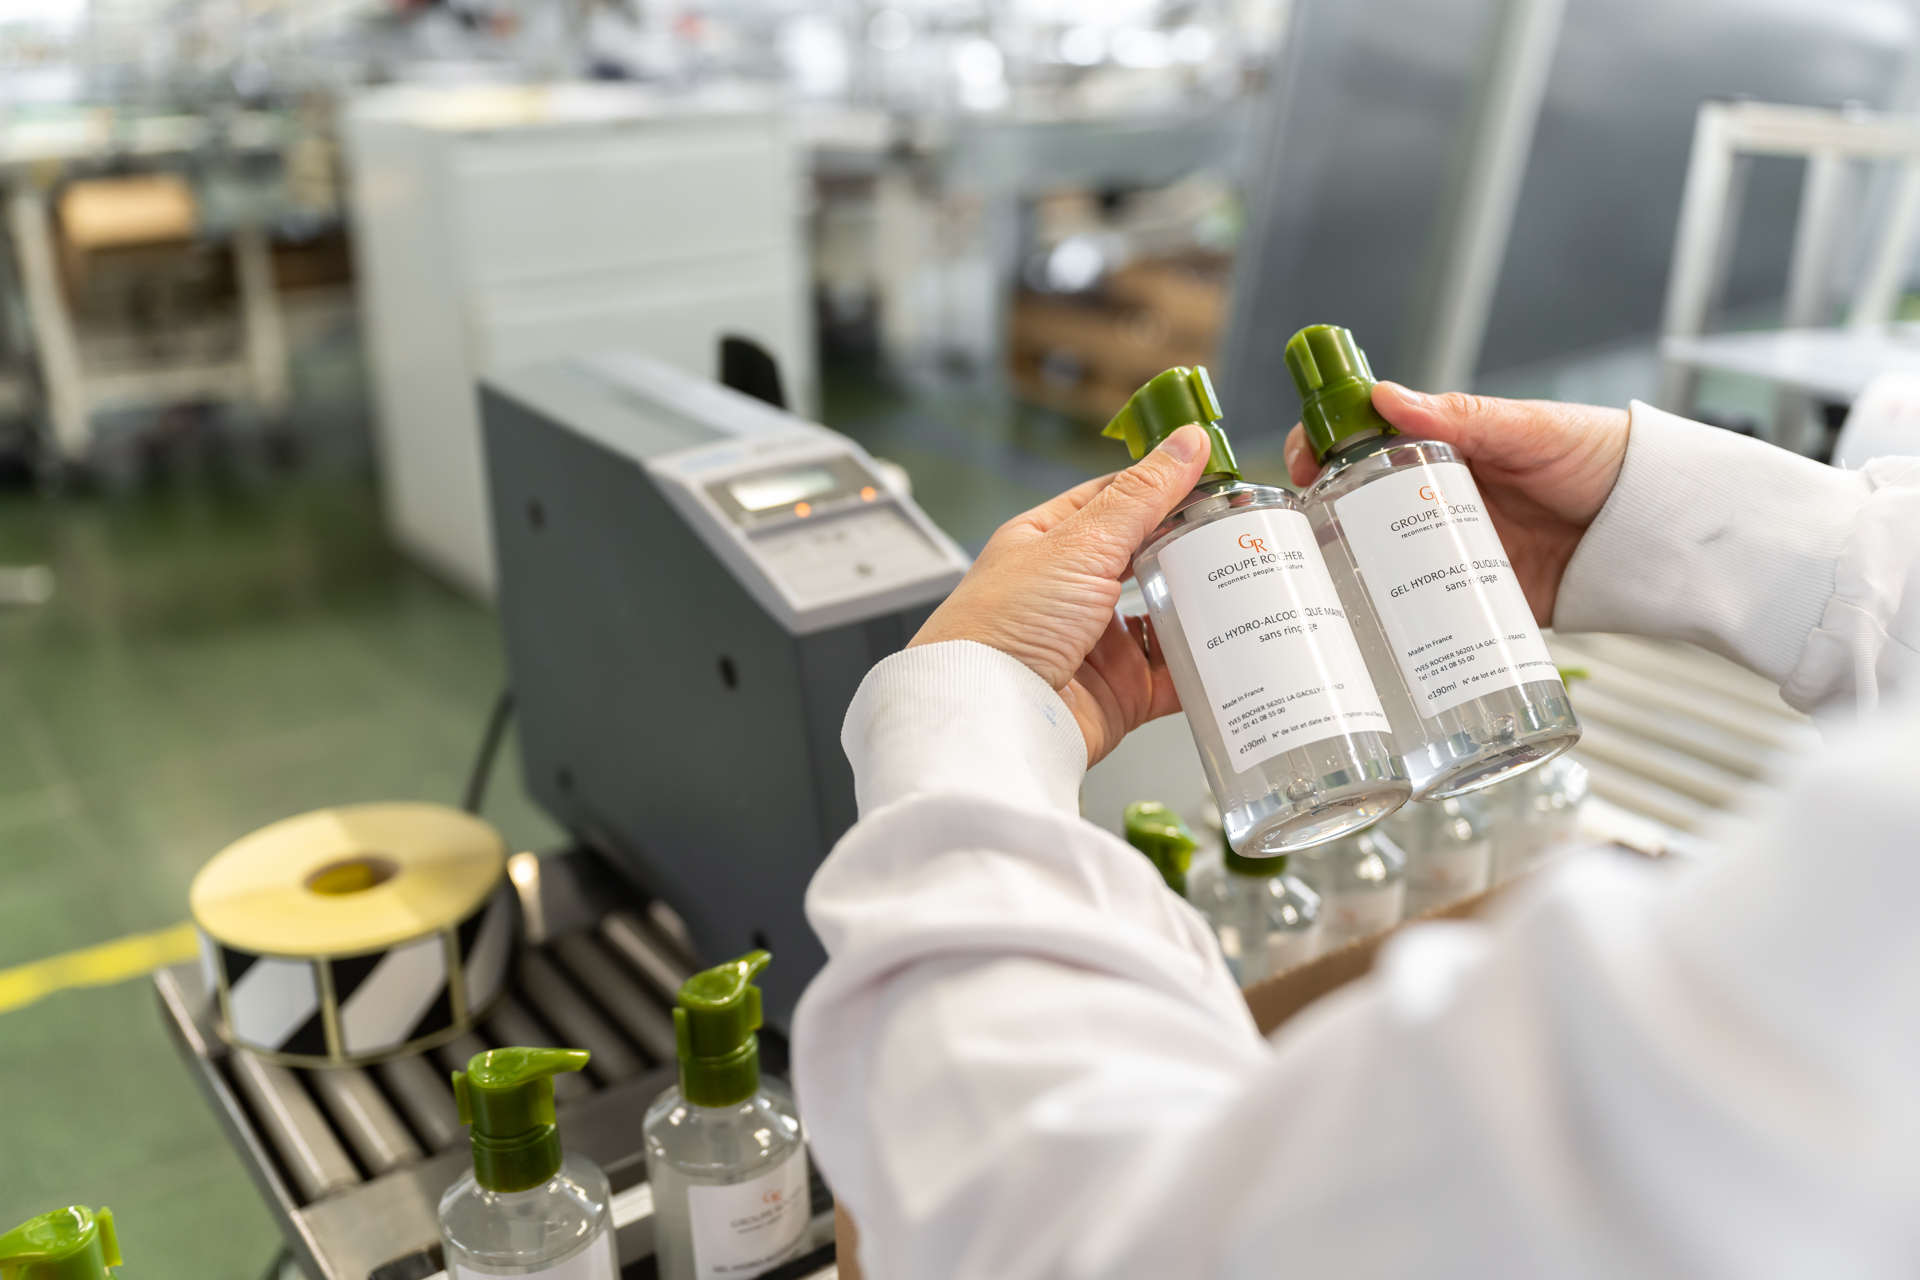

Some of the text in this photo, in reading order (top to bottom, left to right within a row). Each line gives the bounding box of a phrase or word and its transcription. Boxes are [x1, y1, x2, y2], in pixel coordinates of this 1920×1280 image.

[1390, 508, 1439, 532] GROUPE
[1401, 524, 1433, 539] reconnect
[1238, 534, 1267, 553] GR
[1208, 551, 1304, 582] GROUPE ROCHER
[1217, 573, 1250, 589] reconnect
[1253, 567, 1275, 578] people
[1445, 580, 1467, 592] sans
[1390, 584, 1410, 598] GEL
[1206, 635, 1224, 650] GEL
[1259, 631, 1282, 643] sans
[1408, 646, 1425, 657] Made
[1432, 634, 1453, 646] France
[1414, 663, 1430, 674] YVES
[1429, 652, 1455, 667] ROCHER
[1455, 645, 1475, 657] 56201
[1475, 642, 1484, 650] LA
[1431, 668, 1440, 677] 01
[1440, 664, 1448, 673] 41
[1458, 657, 1466, 666] 55
[1467, 654, 1475, 662] 00
[1471, 674, 1480, 682] de
[1480, 671, 1489, 680] lot
[1222, 698, 1238, 710] Made
[1244, 686, 1265, 699] France
[1228, 717, 1242, 727] YVES
[1242, 705, 1266, 720] ROCHER
[1267, 697, 1286, 709] 56201
[1286, 693, 1295, 702] LA
[1295, 687, 1321, 699] GACILLY
[1243, 721, 1251, 730] 01
[1251, 717, 1258, 725] 41
[1268, 710, 1276, 719] 55
[1277, 707, 1286, 715] 00
[1281, 727, 1289, 735] de
[1290, 724, 1299, 732] lot
[1308, 718, 1322, 727] date
